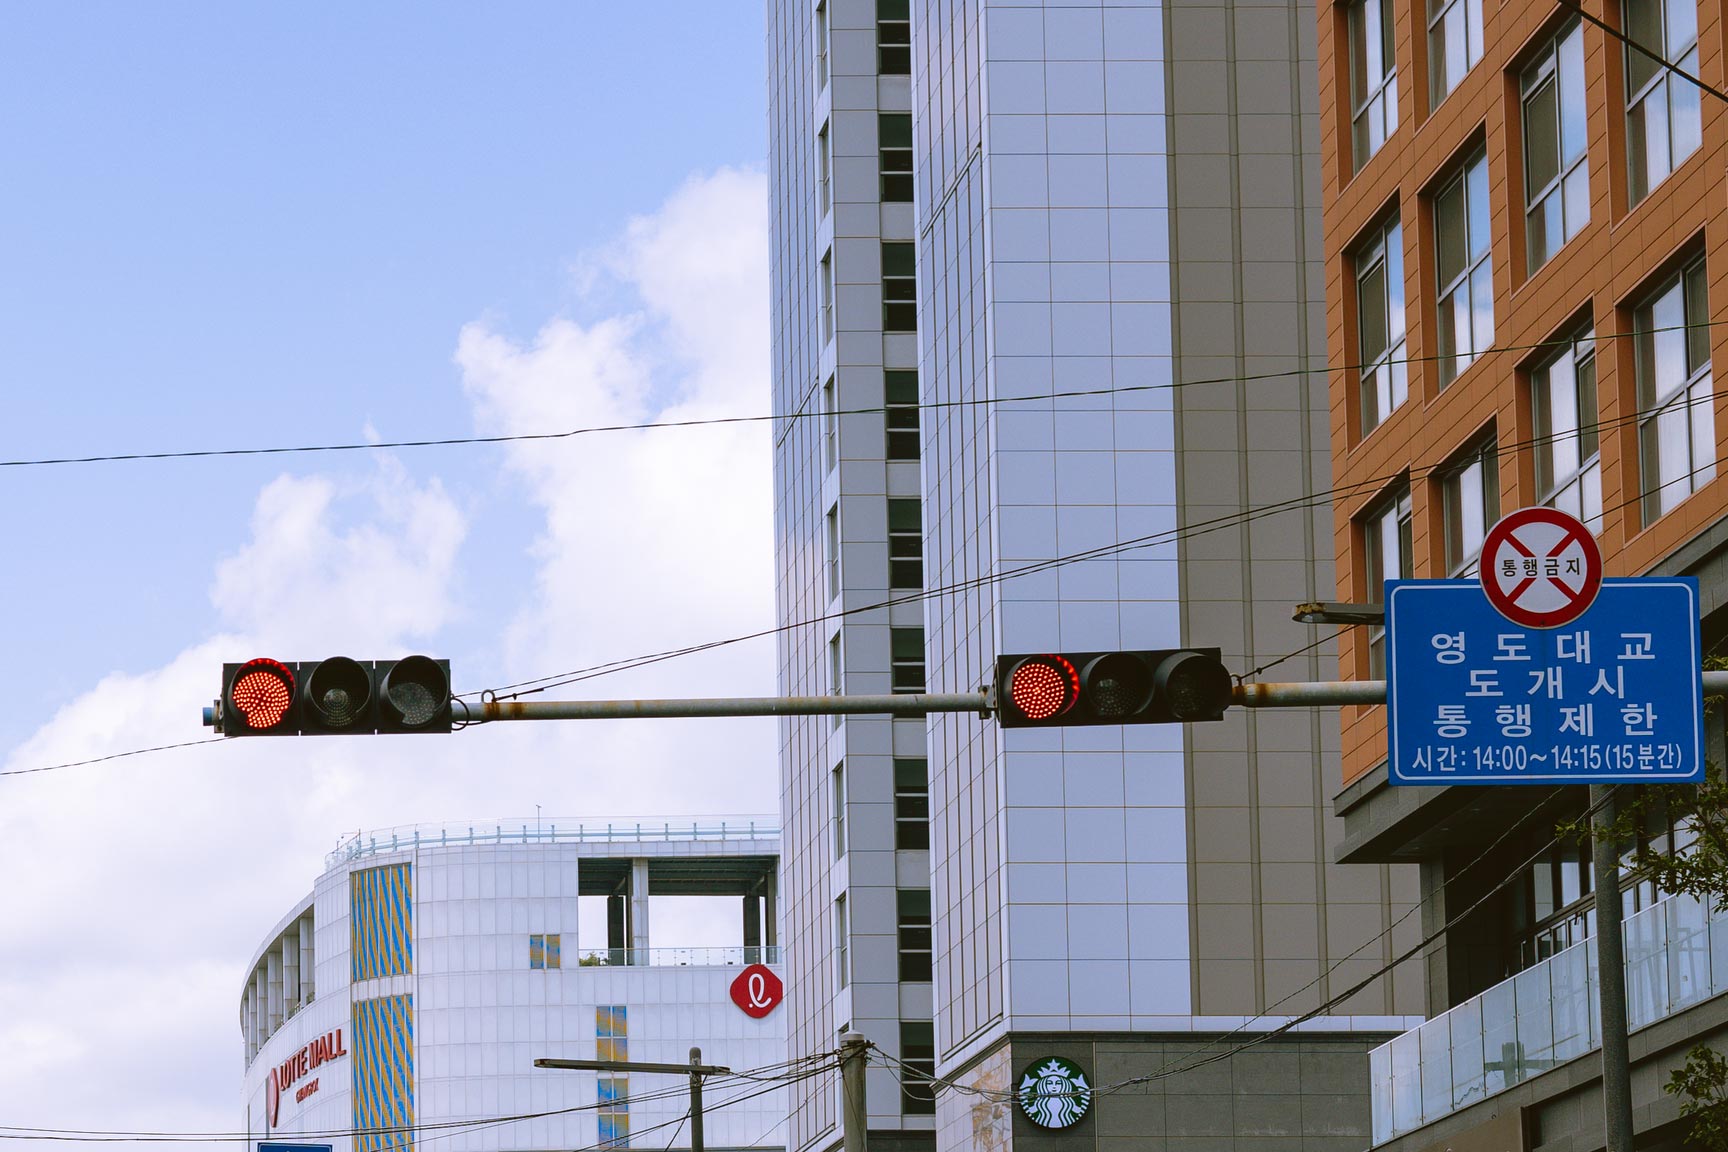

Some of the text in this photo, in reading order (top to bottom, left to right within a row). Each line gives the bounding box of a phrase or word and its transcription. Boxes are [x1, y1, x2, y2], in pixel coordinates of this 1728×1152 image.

[1501, 558, 1581, 577] 통행금지
[1430, 630, 1656, 665] 영도대교
[1464, 665, 1626, 700] 도개시
[1432, 702, 1659, 737] 통행제한
[279, 1028, 347, 1092] LOTTE MALL
